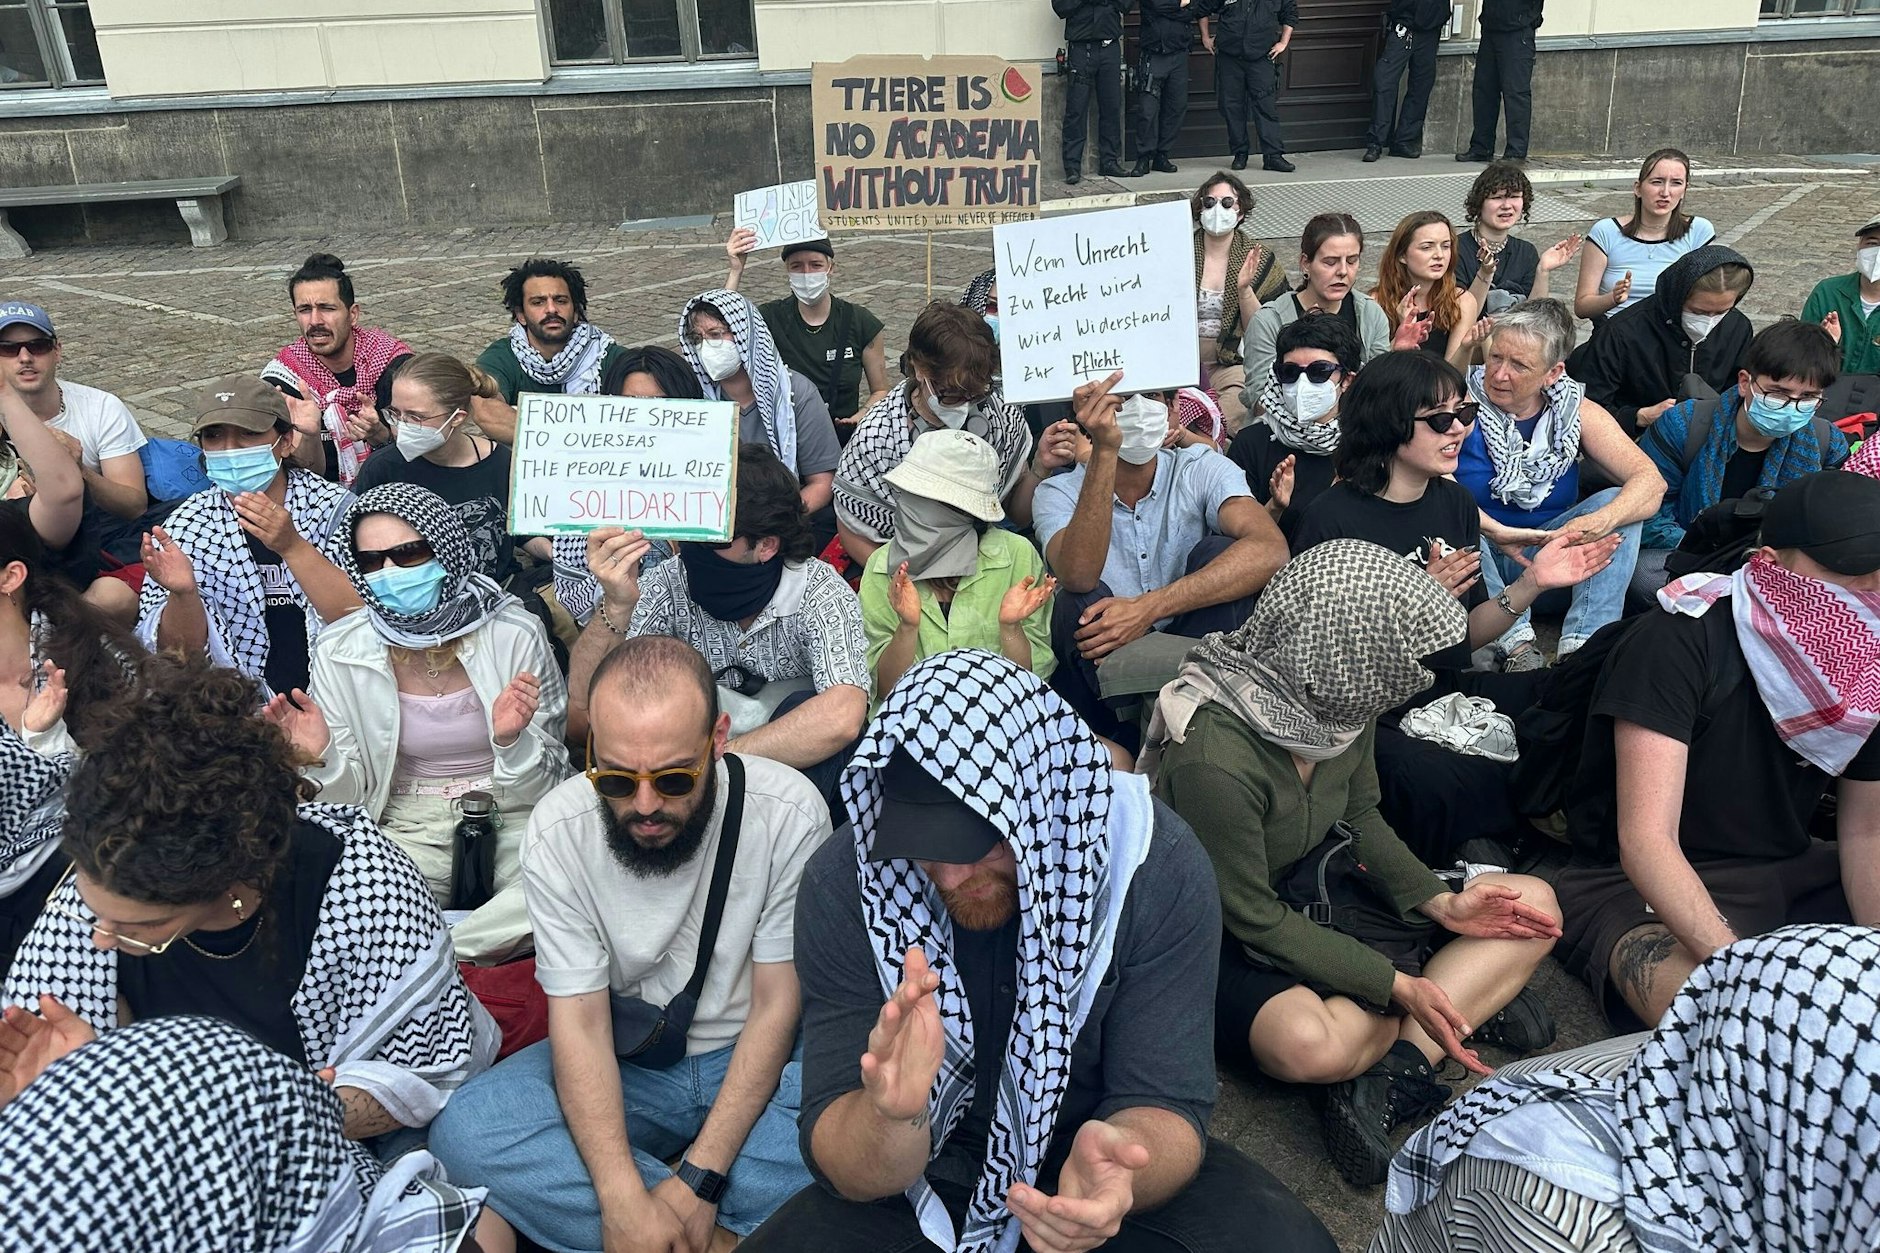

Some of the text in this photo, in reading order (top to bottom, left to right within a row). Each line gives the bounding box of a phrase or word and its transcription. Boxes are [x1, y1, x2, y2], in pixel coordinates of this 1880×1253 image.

[832, 75, 992, 112] THERE IS
[826, 116, 1040, 160] NO ACADEMIA
[823, 164, 1037, 211] WITHOUT TRUTH
[827, 214, 880, 226] STUDENTS
[887, 213, 928, 226] UNITED
[957, 212, 987, 226] NEVER
[1006, 232, 1150, 278] Wenn Unrecht
[1043, 283, 1088, 310] Recht
[1100, 274, 1142, 298] wird
[527, 399, 709, 428] FROM THE SPREE
[524, 430, 657, 449] TO OVERSEAS
[522, 459, 726, 479] THE PEOPLE WILL RISE
[523, 489, 729, 528] IN SOLIDARITY
